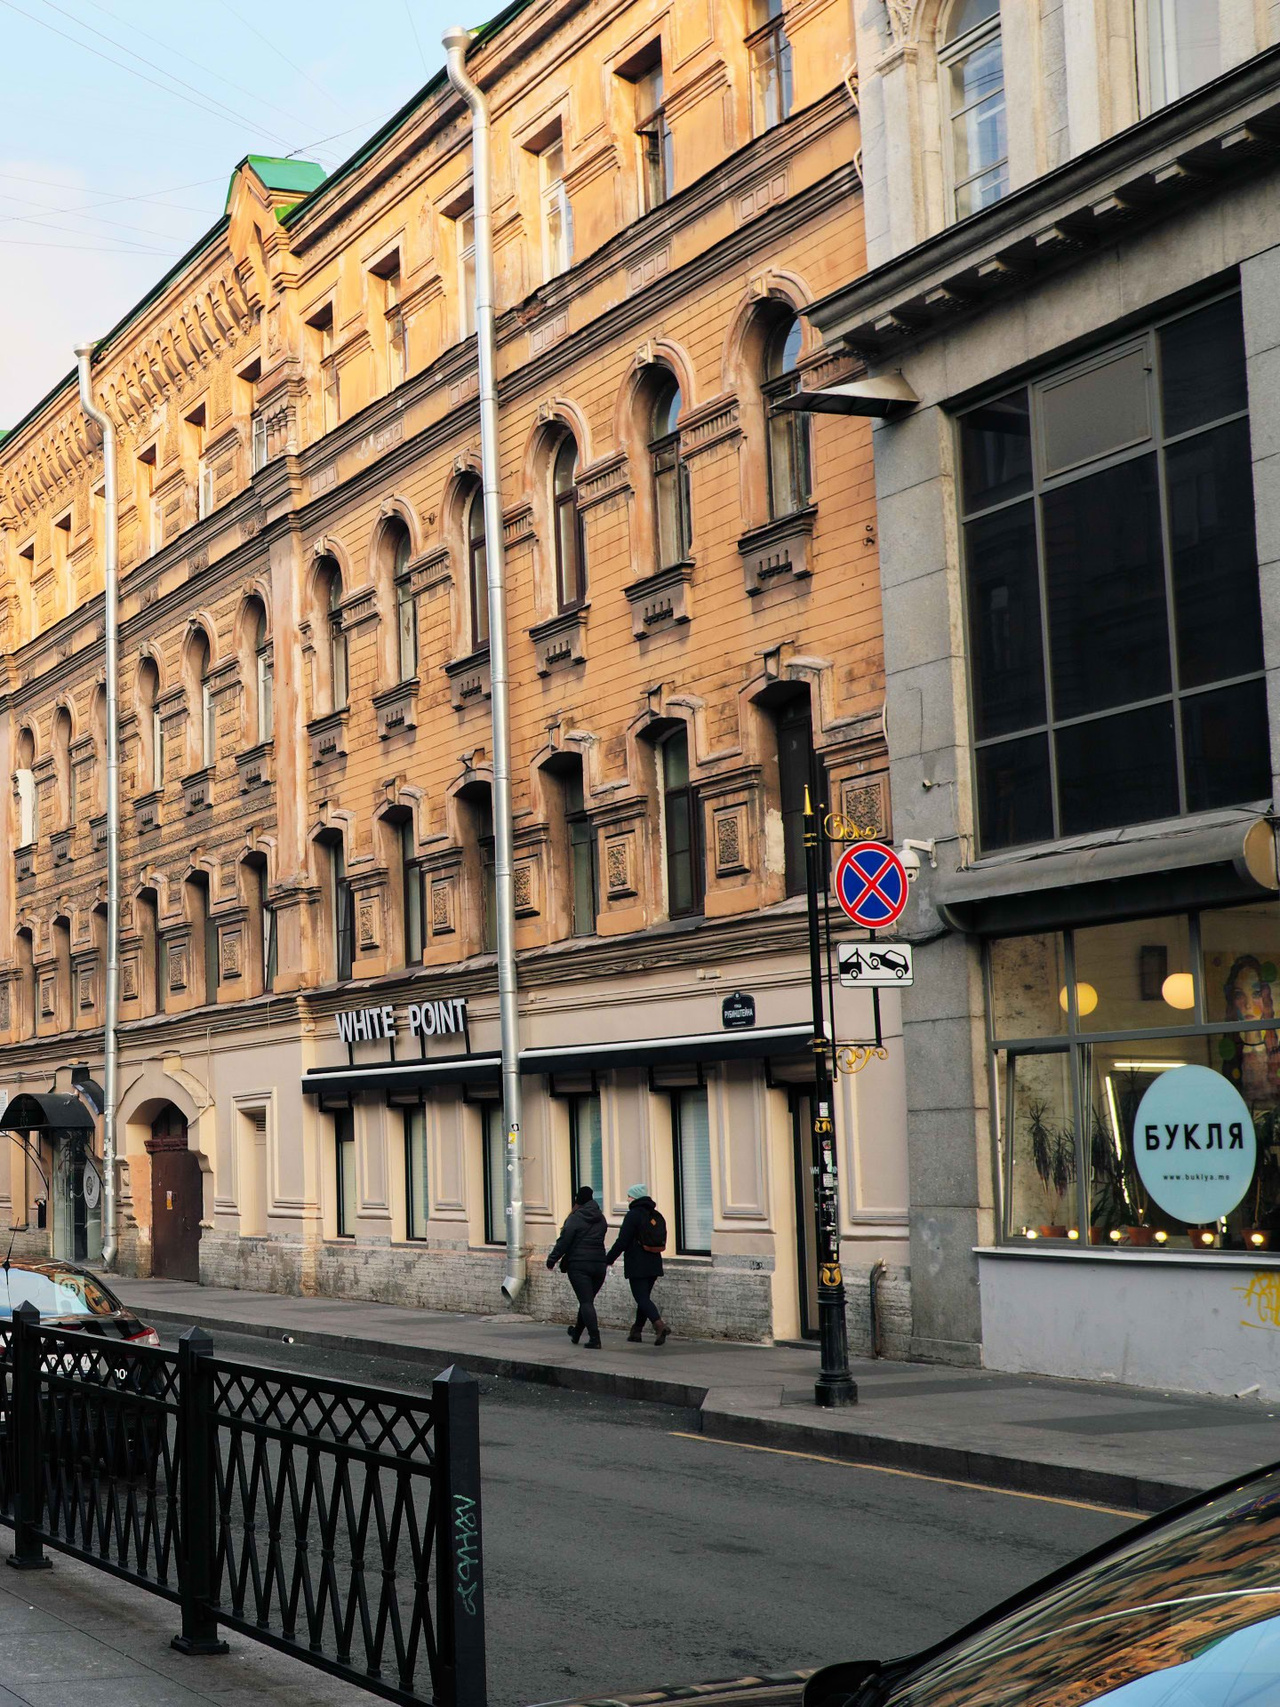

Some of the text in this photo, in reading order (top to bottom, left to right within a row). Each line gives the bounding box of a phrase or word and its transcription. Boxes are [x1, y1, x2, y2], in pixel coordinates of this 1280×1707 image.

[335, 998, 465, 1042] WHITE POINT
[1145, 1122, 1244, 1151] БУКЛЯ
